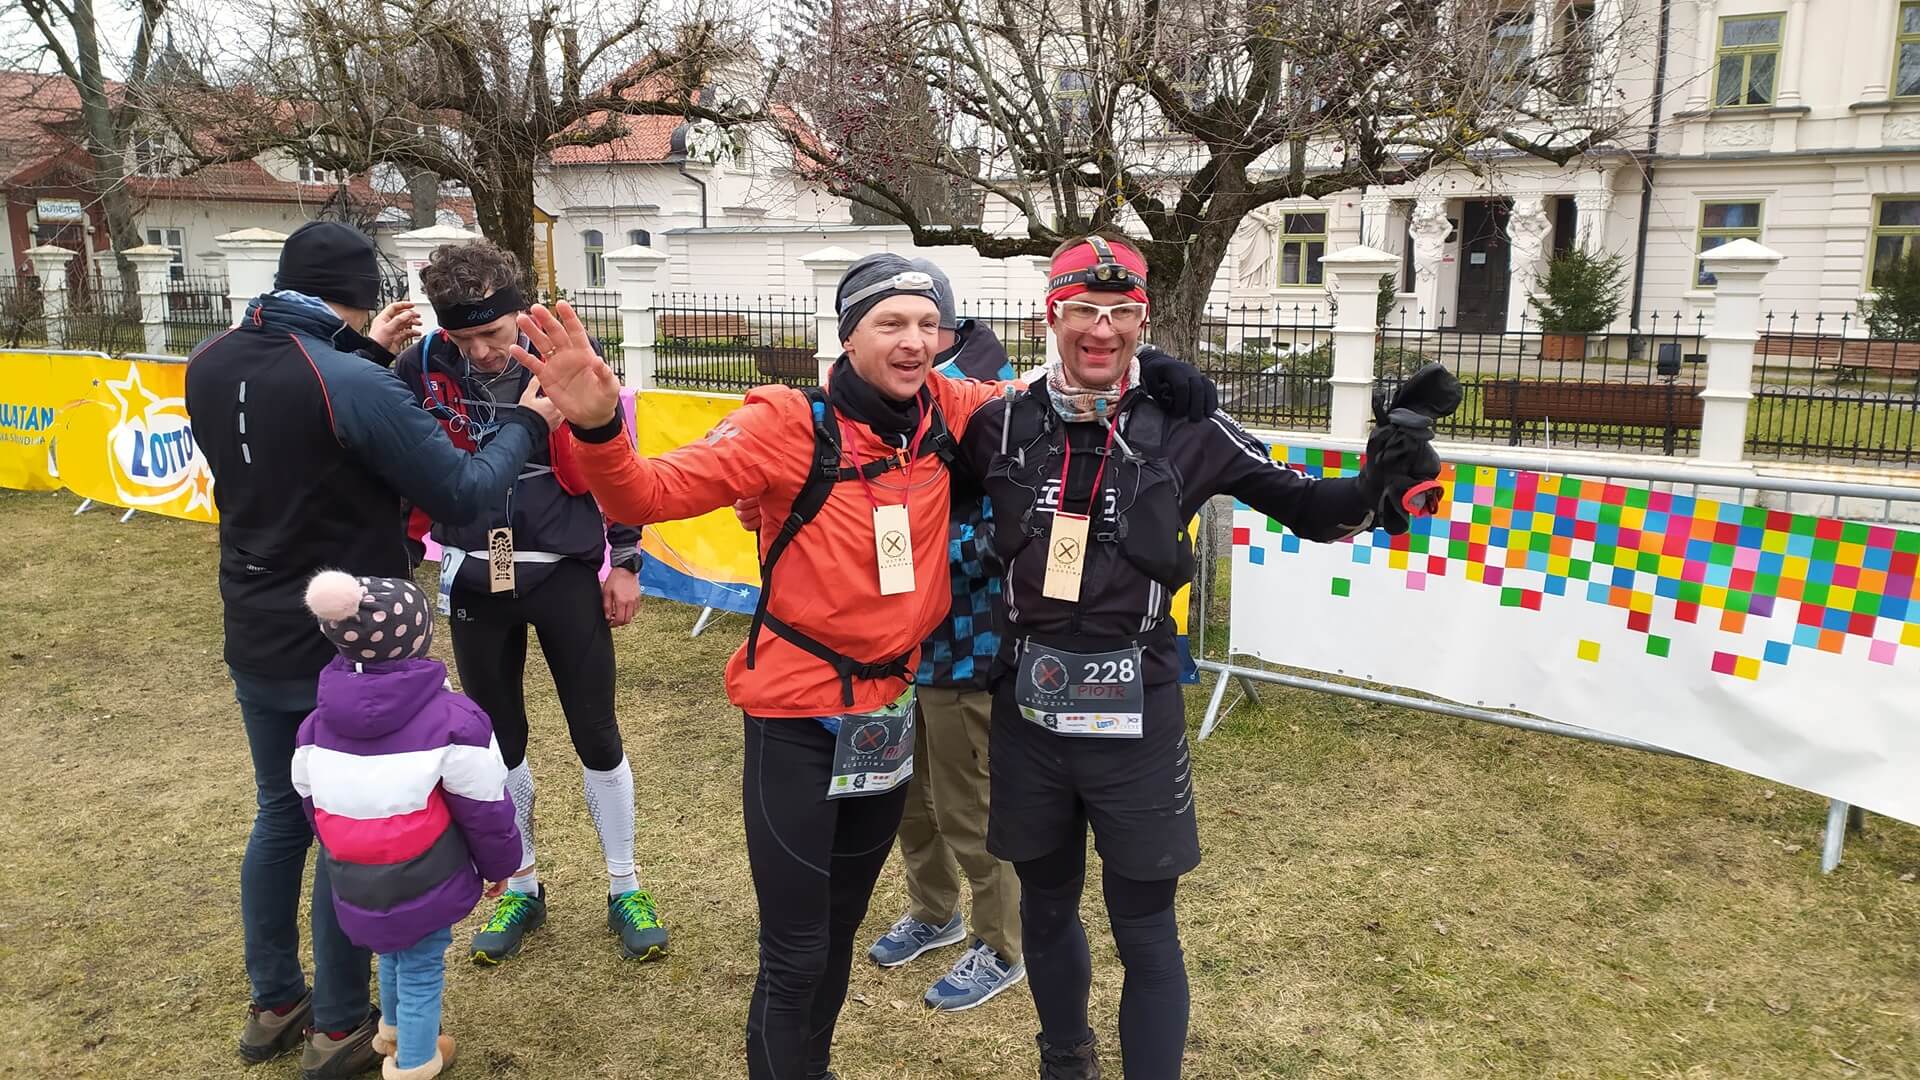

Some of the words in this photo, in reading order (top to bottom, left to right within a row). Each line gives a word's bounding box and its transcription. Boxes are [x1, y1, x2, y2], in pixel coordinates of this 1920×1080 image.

[131, 425, 193, 478] LOTTO
[1083, 658, 1135, 683] 228
[1076, 684, 1127, 697] PIOTR
